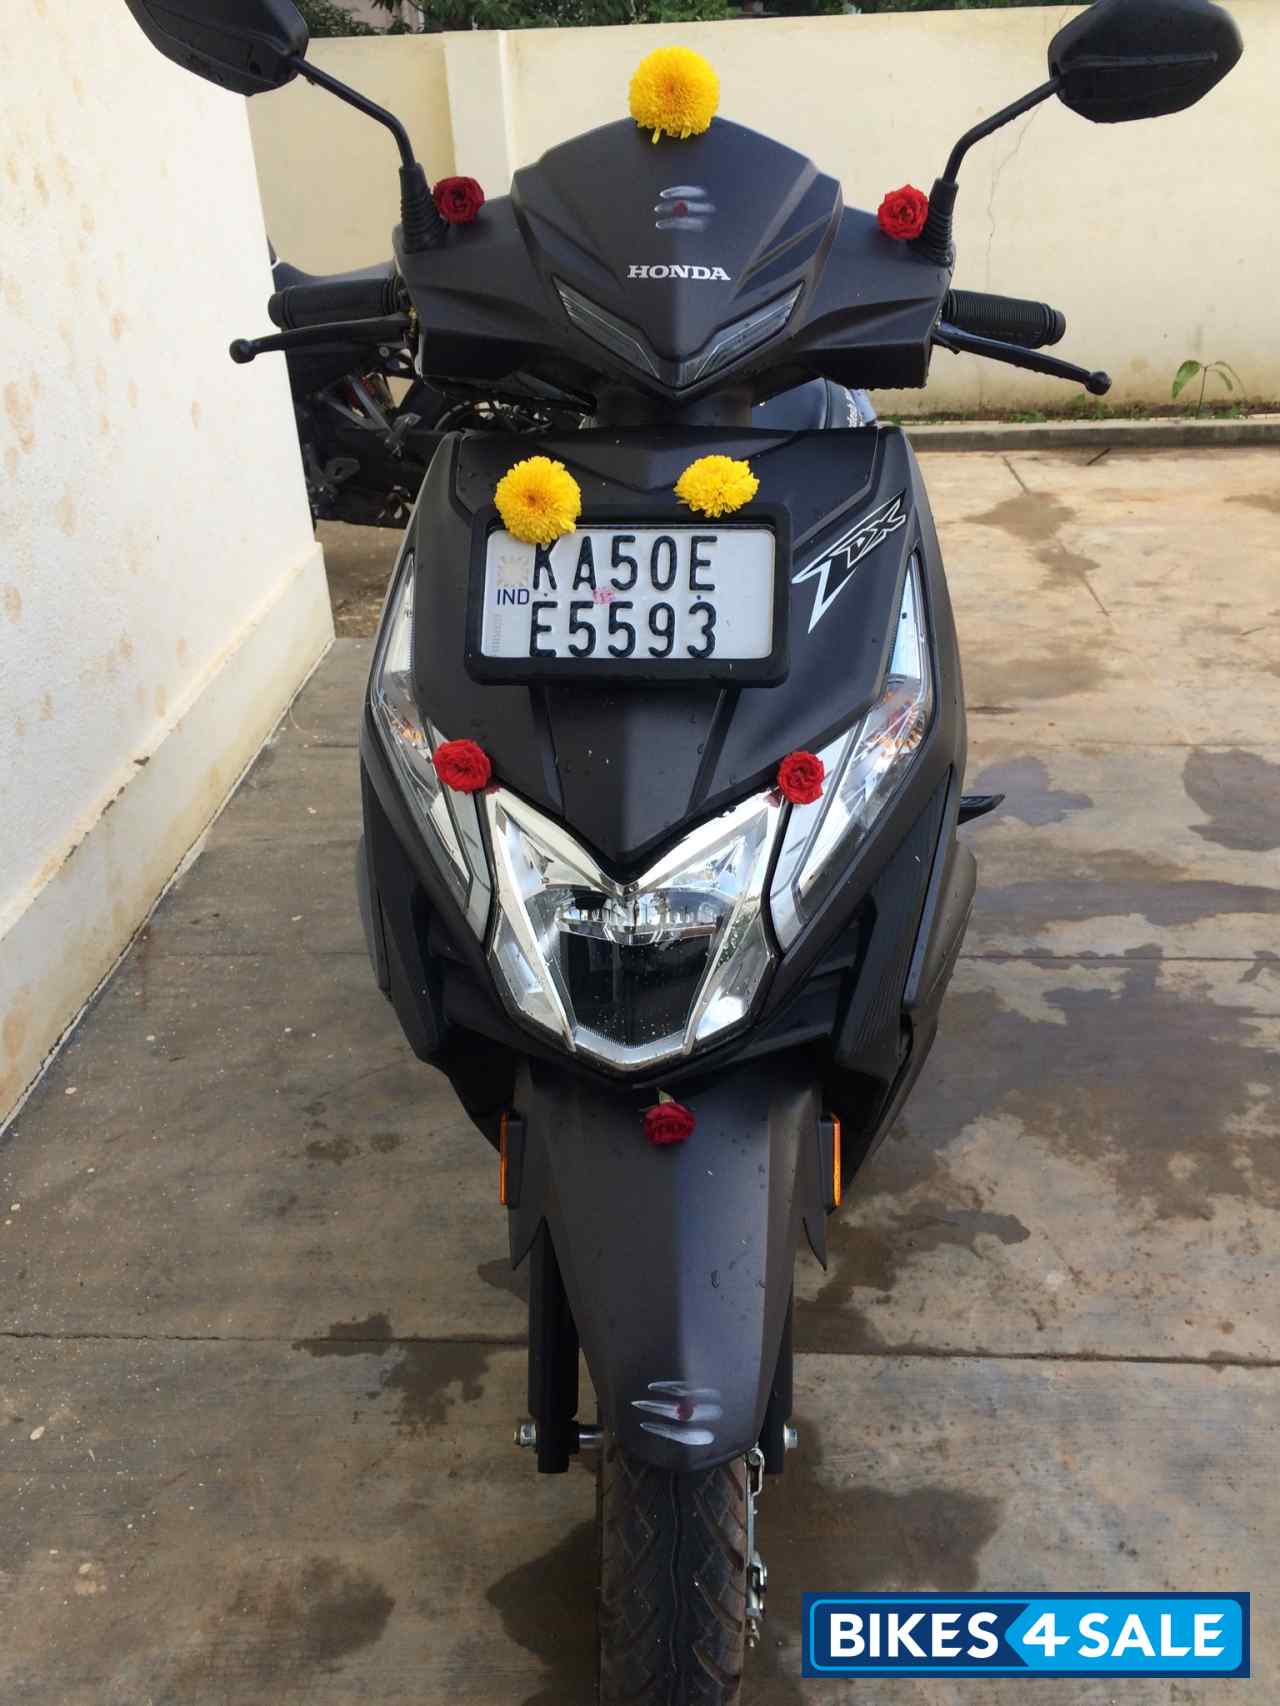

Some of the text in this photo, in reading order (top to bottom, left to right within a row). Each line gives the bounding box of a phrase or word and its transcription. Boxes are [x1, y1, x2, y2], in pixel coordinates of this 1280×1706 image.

[627, 264, 731, 281] HONDA
[532, 534, 718, 591] KA50E
[497, 588, 530, 606] IND
[529, 601, 717, 658] E5593
